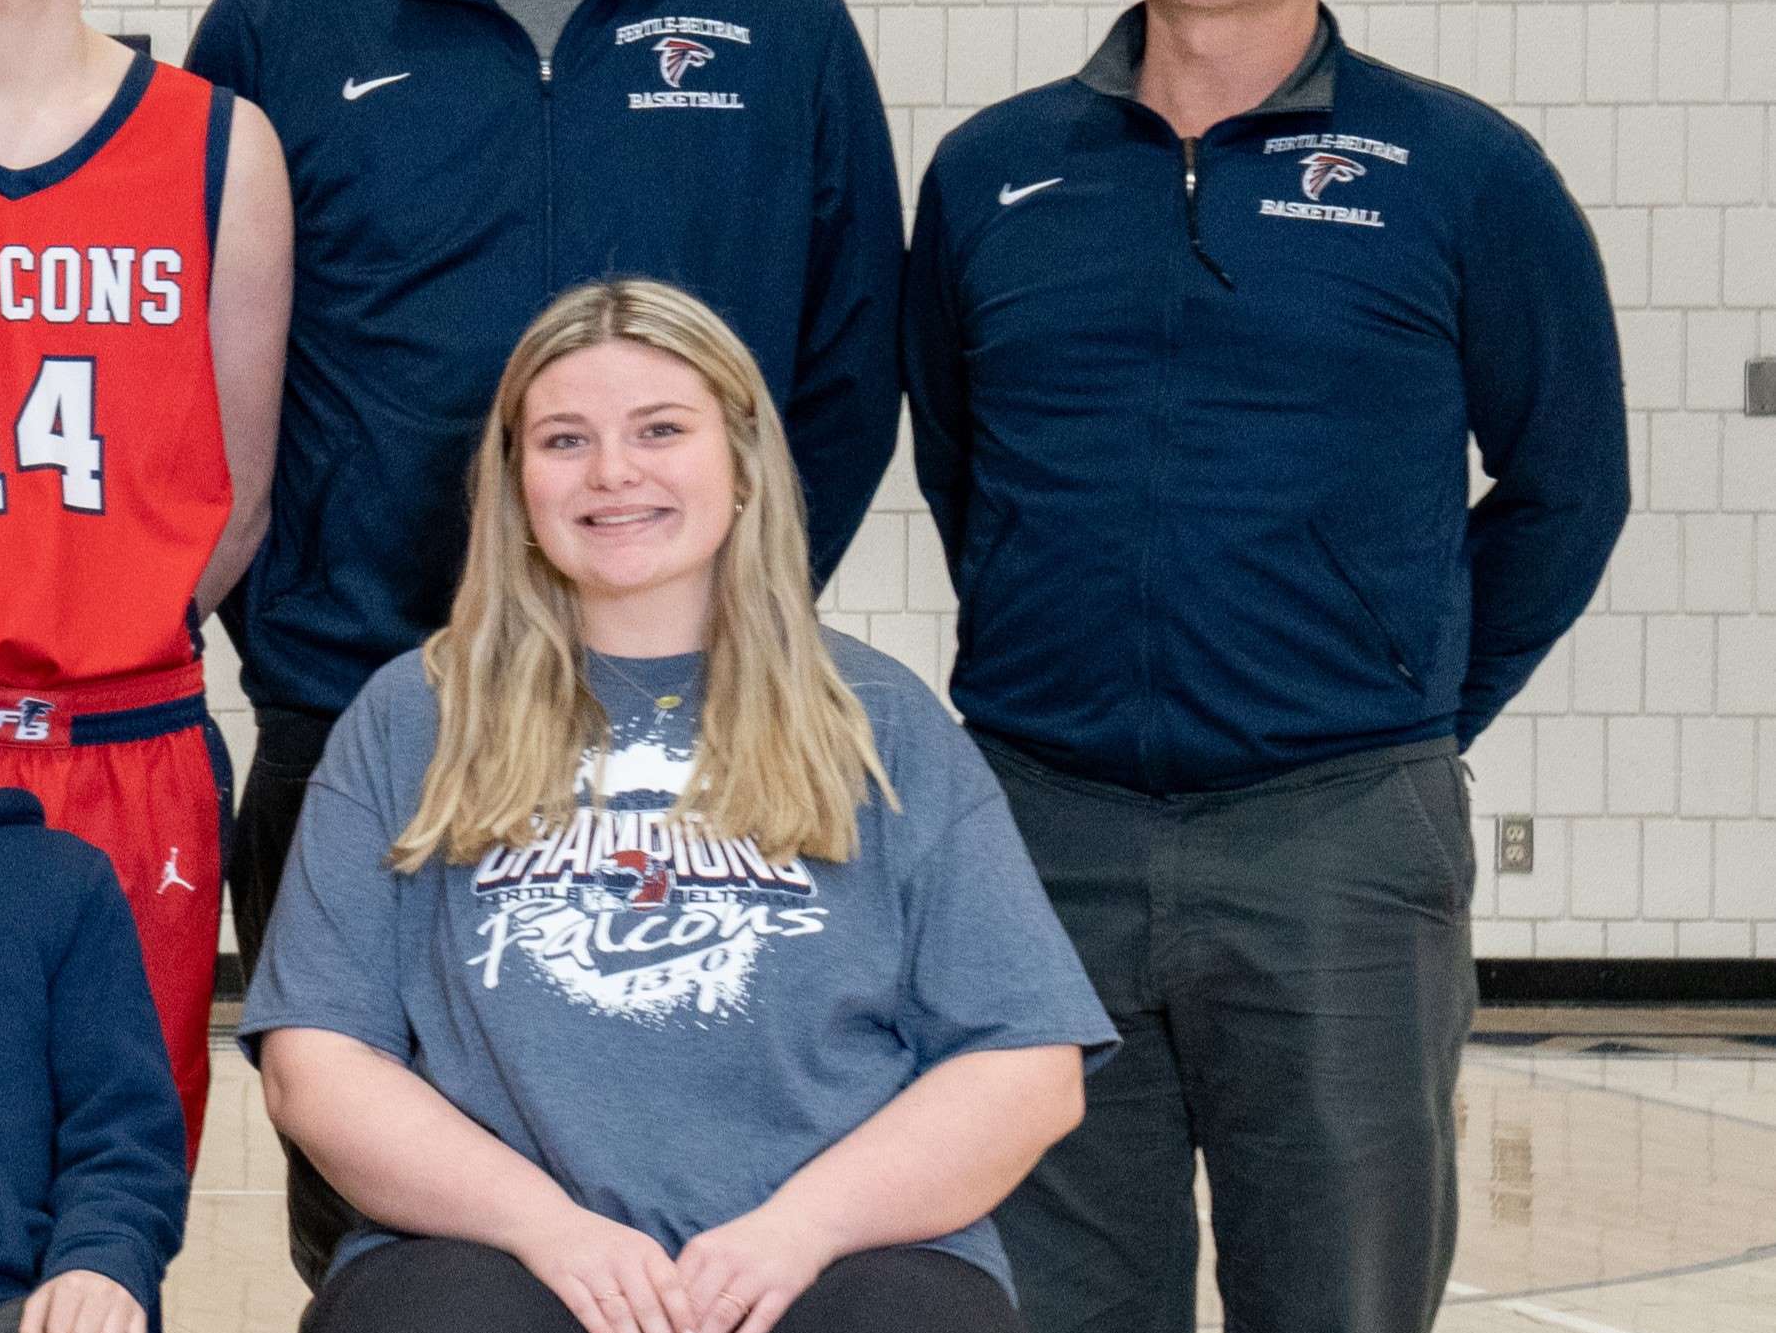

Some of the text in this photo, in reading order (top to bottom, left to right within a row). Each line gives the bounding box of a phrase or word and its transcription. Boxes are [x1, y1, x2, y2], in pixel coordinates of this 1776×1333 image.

[627, 92, 745, 109] BASKETBALL
[1259, 199, 1386, 228] BASKETBALL
[465, 898, 830, 989] Falcons
